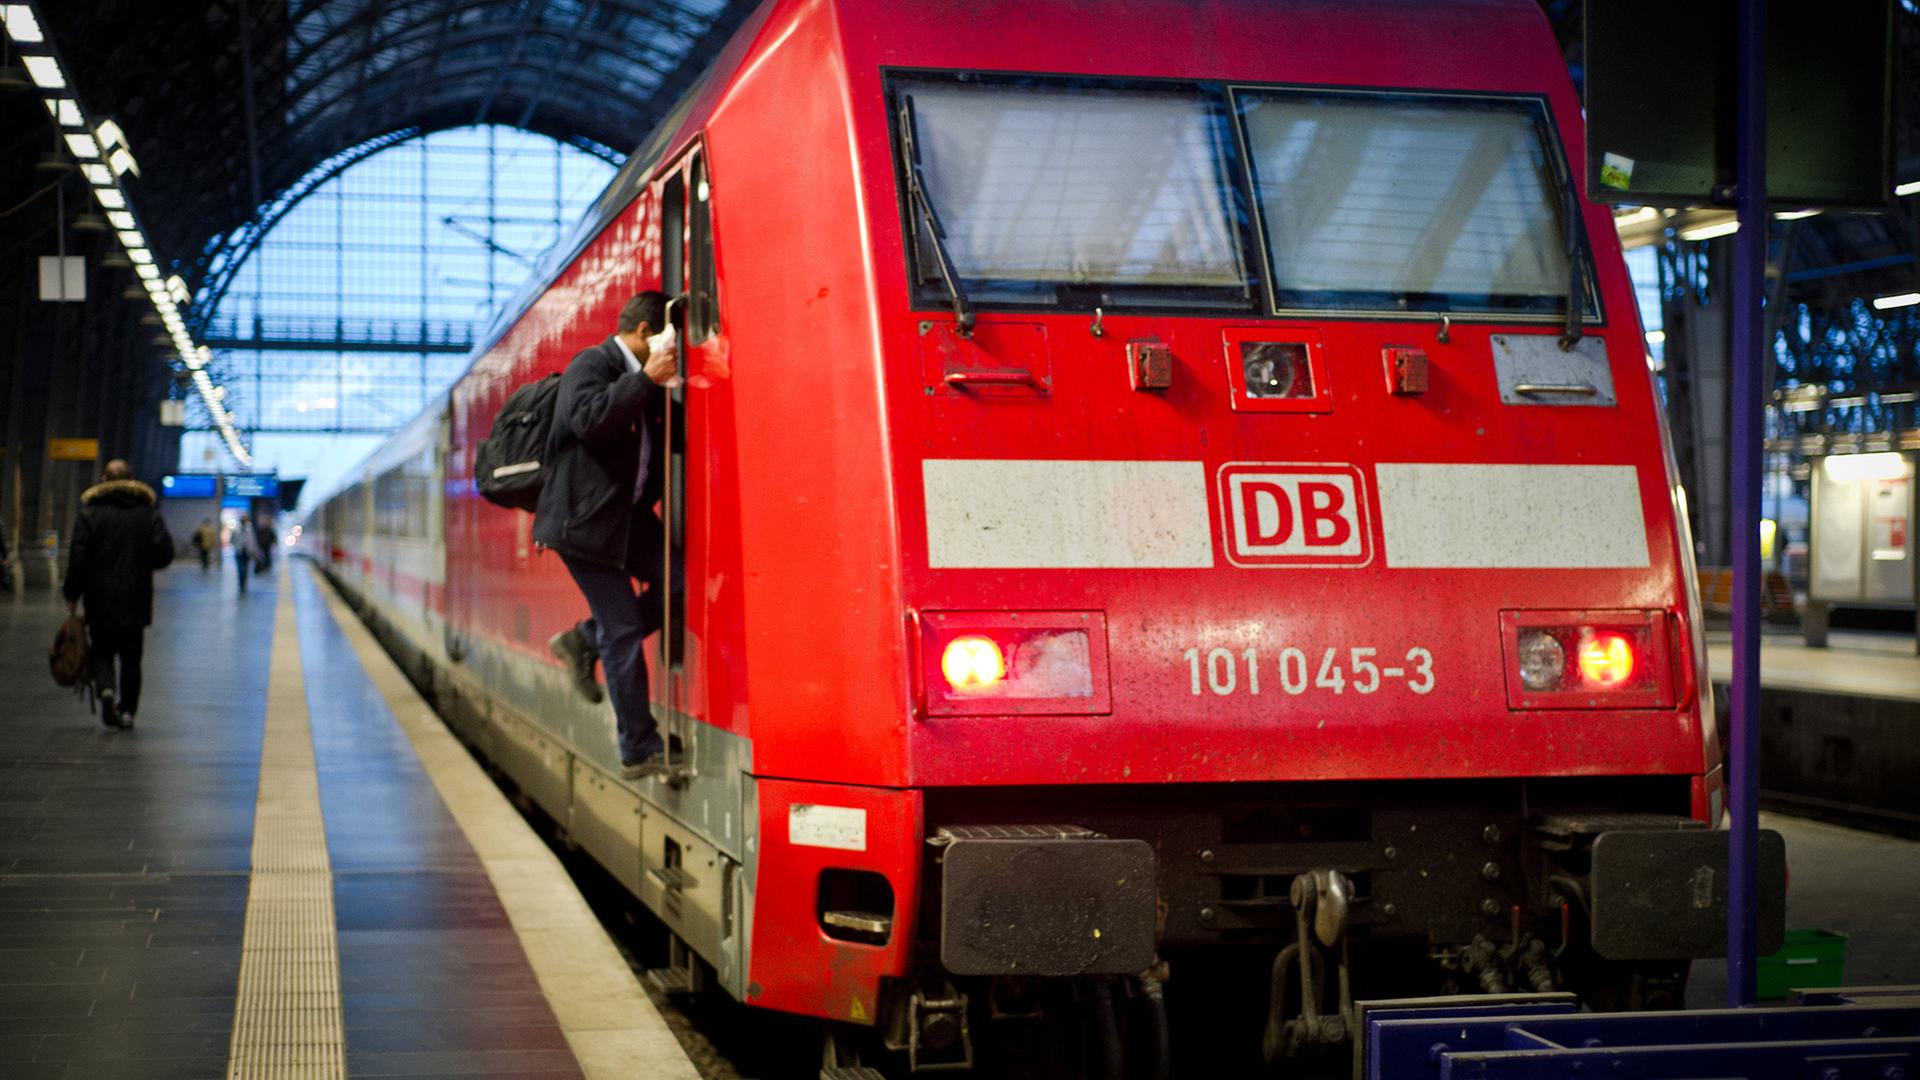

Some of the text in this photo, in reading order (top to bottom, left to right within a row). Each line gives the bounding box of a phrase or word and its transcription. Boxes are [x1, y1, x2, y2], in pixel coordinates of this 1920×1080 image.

[1240, 481, 1352, 547] DB
[1183, 646, 1436, 696] 101 045-3
